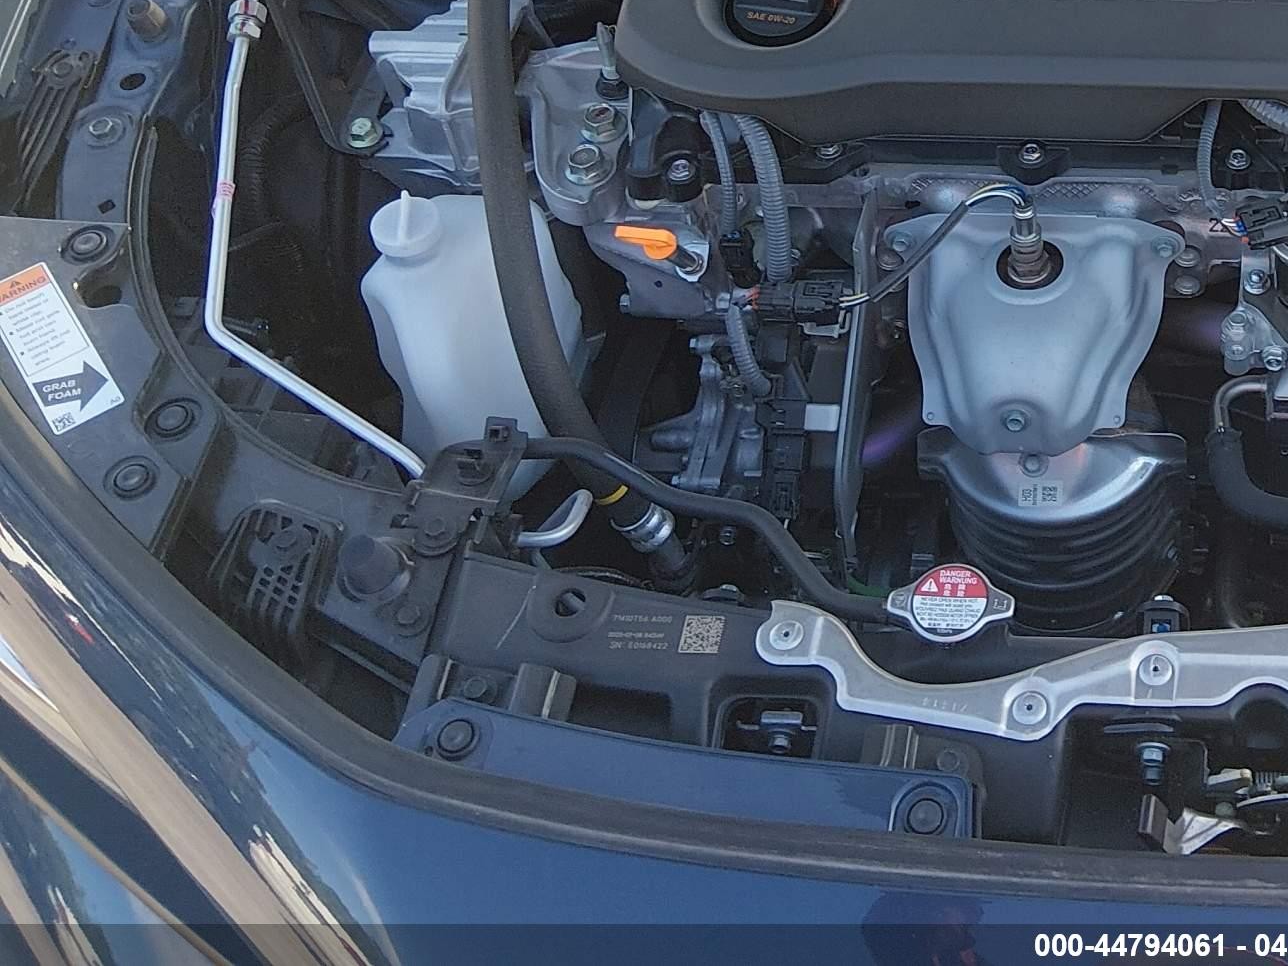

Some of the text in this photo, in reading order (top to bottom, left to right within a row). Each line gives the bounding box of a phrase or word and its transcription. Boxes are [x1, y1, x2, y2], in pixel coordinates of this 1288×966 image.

[746, 10, 796, 25] SAE 0W-20
[0, 275, 46, 302] ARNING
[43, 379, 76, 393] GRAB
[48, 388, 82, 402] FOAM
